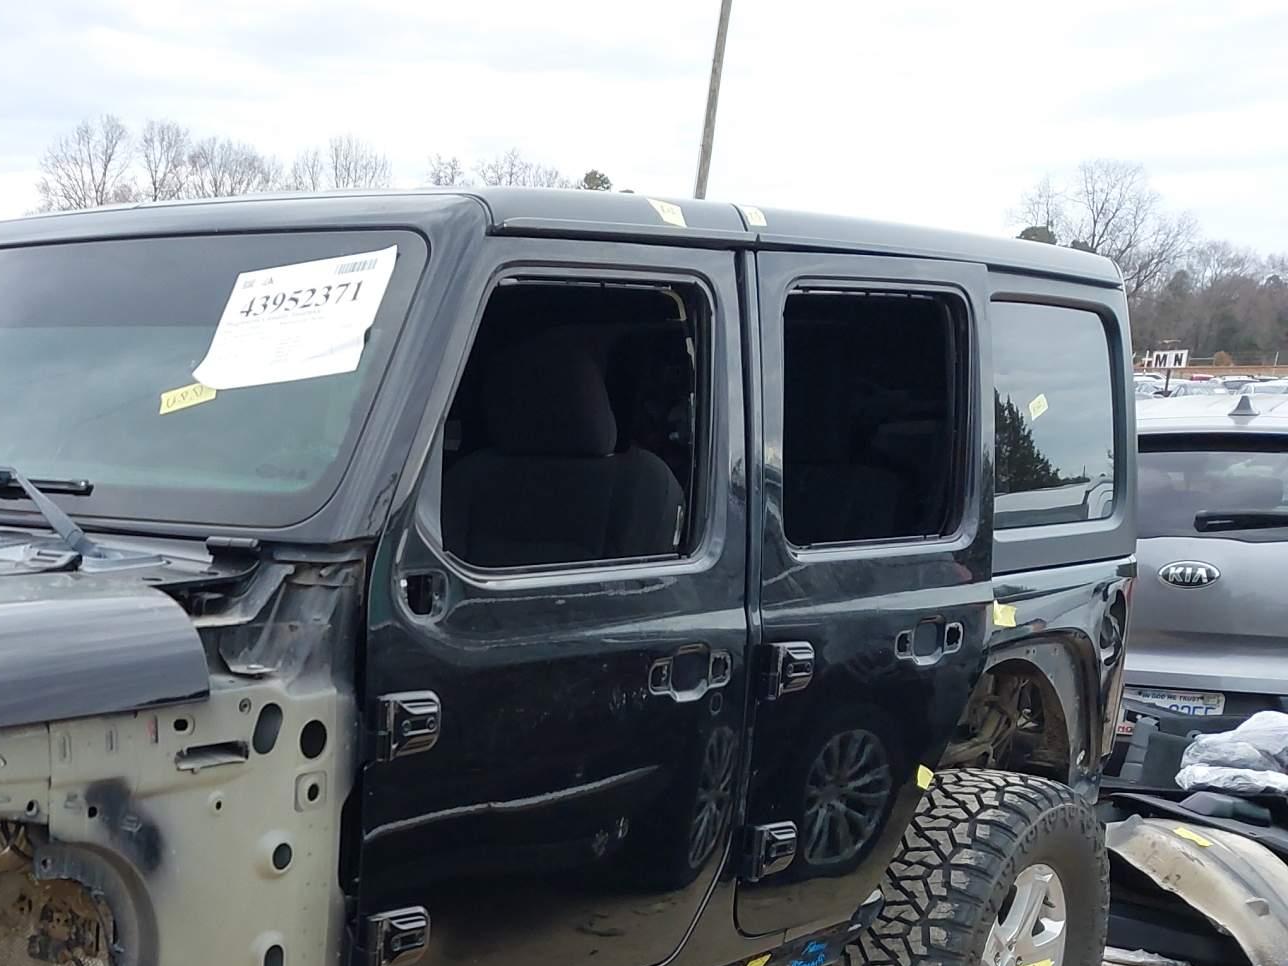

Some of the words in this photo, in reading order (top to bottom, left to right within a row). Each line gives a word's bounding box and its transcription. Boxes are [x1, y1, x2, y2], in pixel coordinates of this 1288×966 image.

[240, 280, 364, 318] 43952371
[1154, 353, 1168, 367] M
[1173, 352, 1184, 367] N
[1168, 566, 1209, 583] KIA
